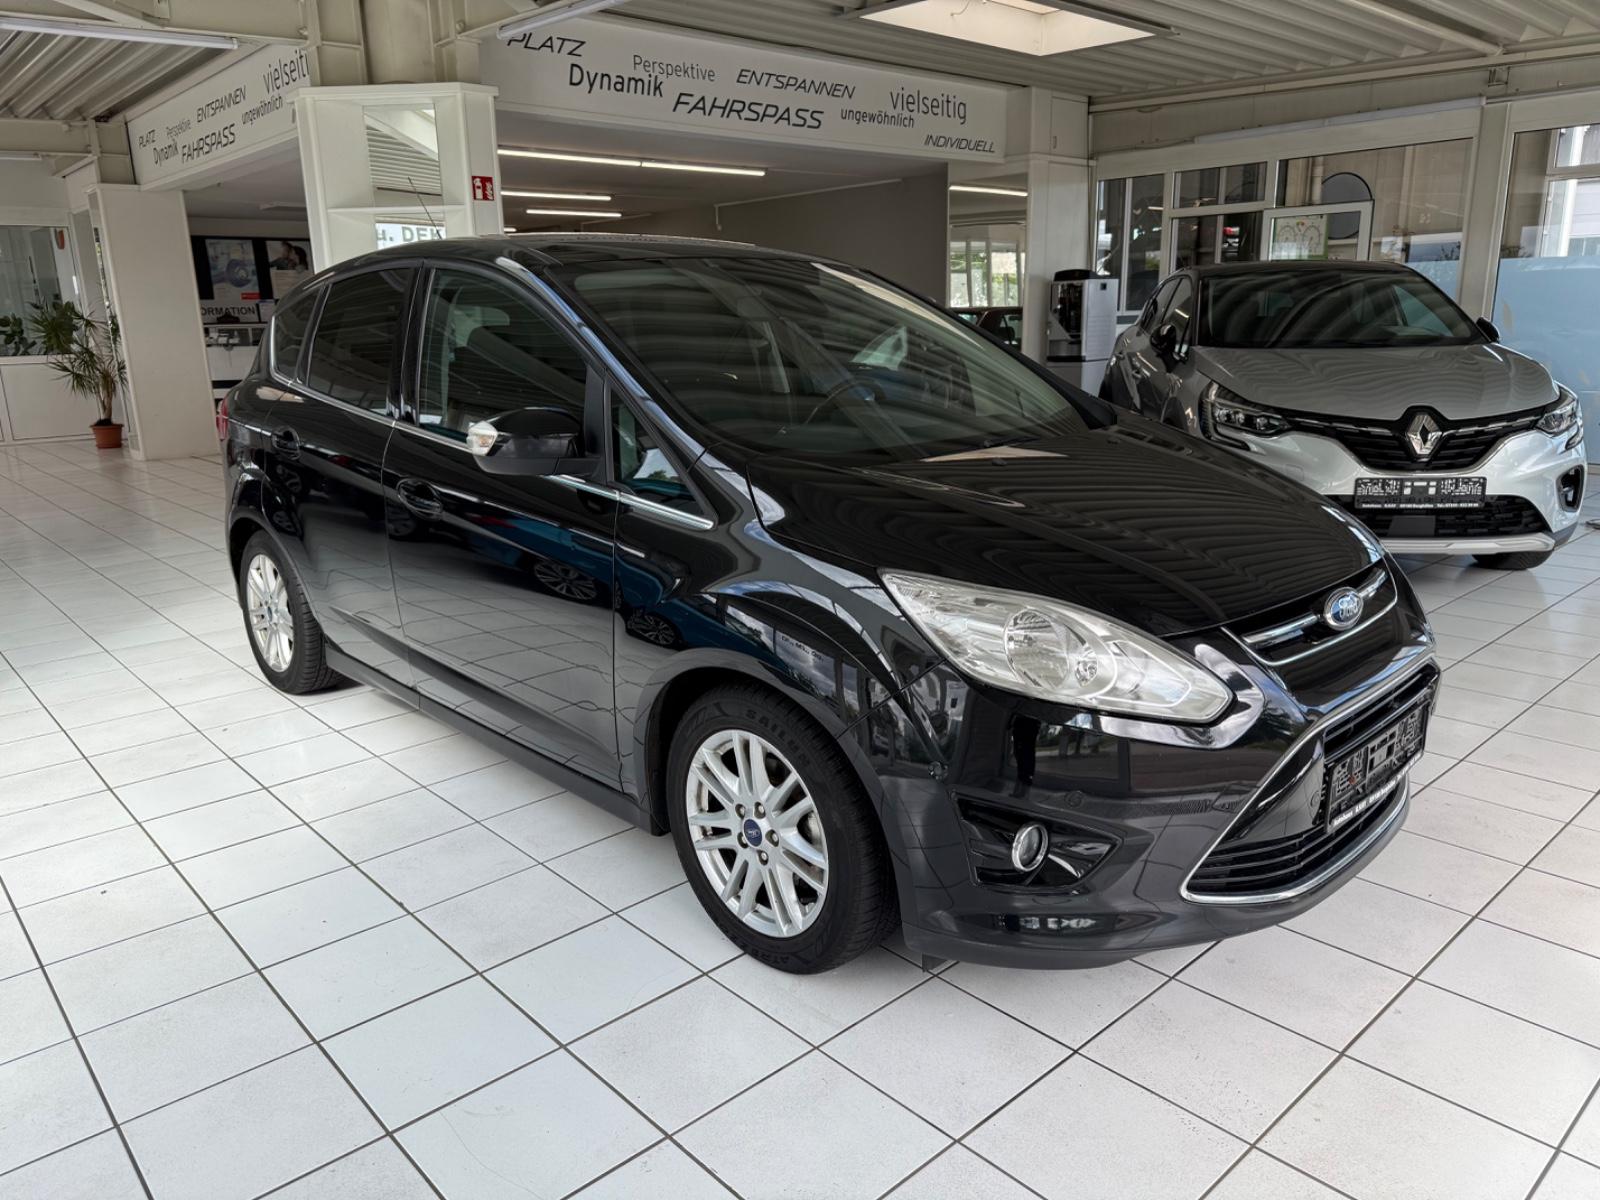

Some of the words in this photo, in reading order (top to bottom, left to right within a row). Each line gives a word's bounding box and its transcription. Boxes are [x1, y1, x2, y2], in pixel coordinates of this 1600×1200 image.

[263, 48, 309, 95] vielseiti
[569, 63, 664, 98] Dynamik
[633, 54, 716, 82] Perspektive
[736, 68, 856, 100] ENTSPANNEN
[196, 85, 246, 123] ENTSPANNEN
[241, 94, 283, 126] ungewöhnlich
[672, 92, 824, 130] FAHRSPASS
[840, 106, 915, 129] ungewöhnlich
[890, 86, 967, 125] vielseitig
[138, 129, 156, 149] PLATZ
[152, 138, 180, 167] Dynamik
[181, 123, 236, 164] FAHRSPASS
[924, 134, 996, 153] INDIVIDUELL
[401, 226, 443, 241] DEK
[200, 306, 256, 316] ORMATION
